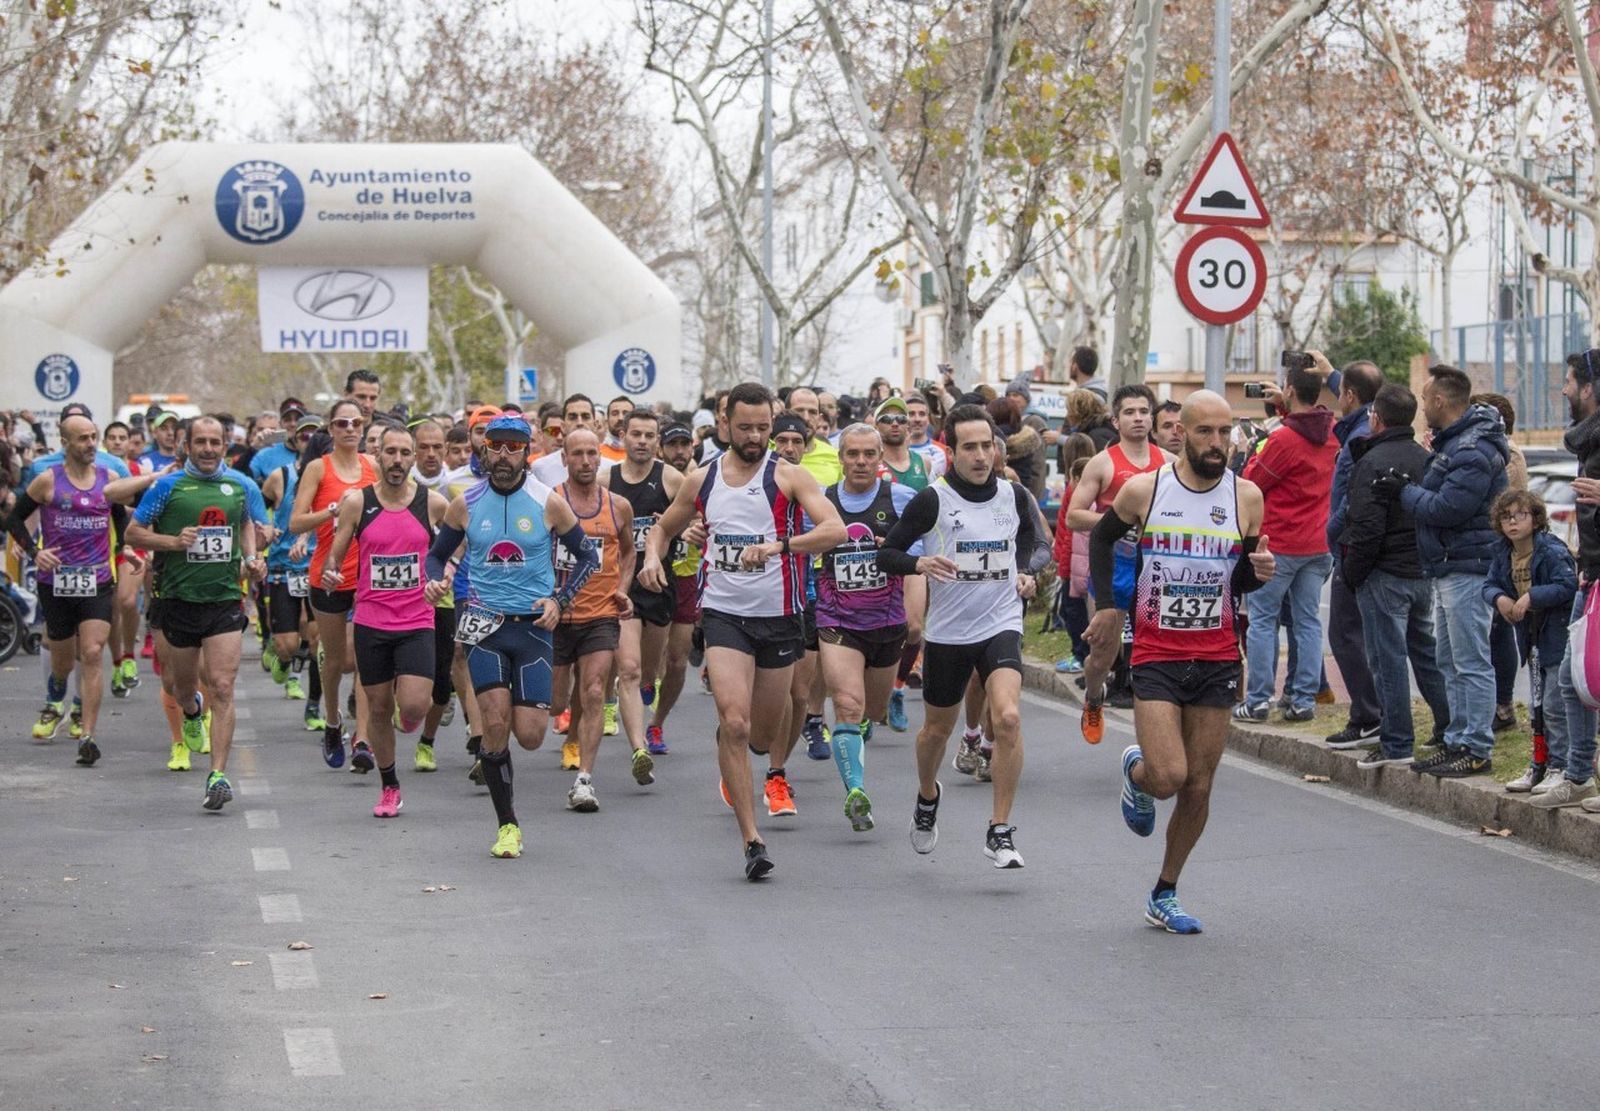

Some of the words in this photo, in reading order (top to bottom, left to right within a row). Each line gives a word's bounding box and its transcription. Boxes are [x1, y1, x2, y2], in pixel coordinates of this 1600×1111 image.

[309, 169, 472, 187] Ayuntamiento
[356, 188, 384, 204] de
[393, 187, 473, 205] Huelva
[393, 210, 410, 221] de
[414, 210, 476, 222] Deportes
[1199, 258, 1246, 290] 30
[279, 329, 408, 349] HYUNDAI
[1038, 396, 1066, 409] ANC
[200, 537, 223, 553] 13
[718, 545, 744, 562] 17
[979, 552, 989, 570] 1
[377, 564, 412, 580] 141
[842, 562, 881, 580] 149
[60, 574, 91, 588] 115
[1167, 598, 1217, 617] 437
[461, 615, 494, 635] 154
